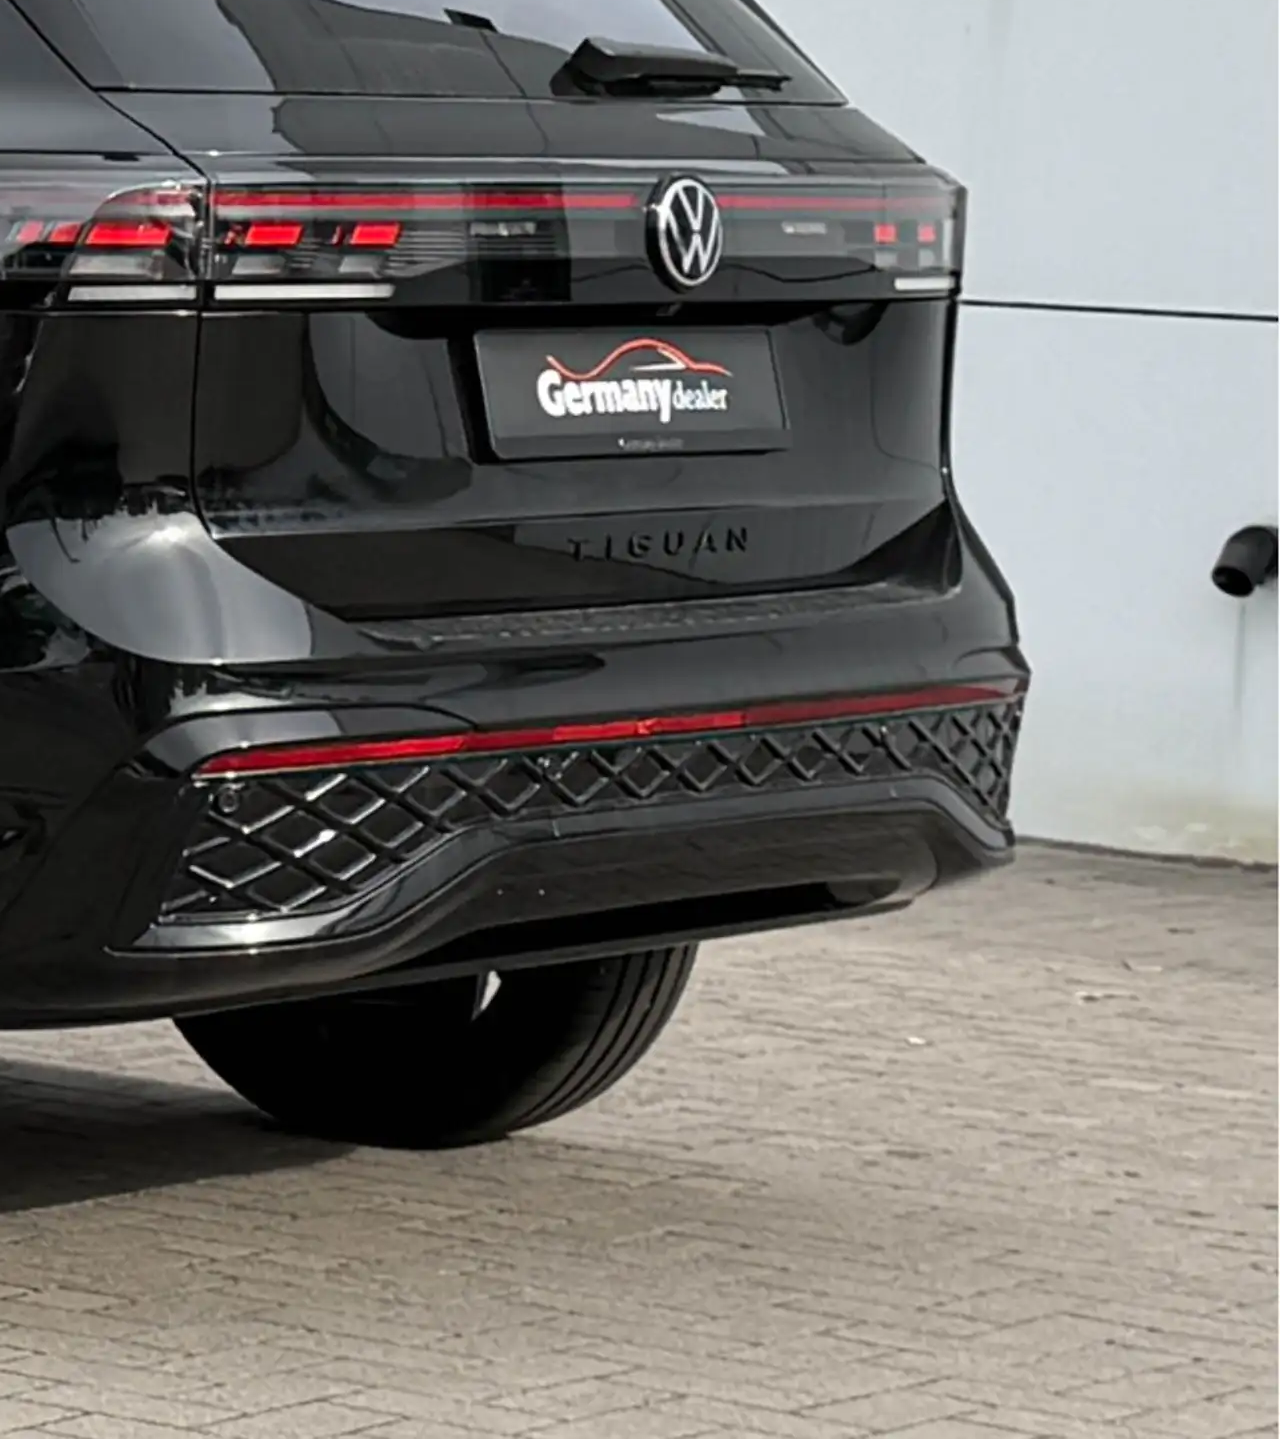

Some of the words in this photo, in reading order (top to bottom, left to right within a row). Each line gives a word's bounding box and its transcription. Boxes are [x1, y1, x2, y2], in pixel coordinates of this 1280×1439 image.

[536, 368, 672, 423] Germany
[671, 380, 729, 411] dealer
[566, 526, 748, 562] TIGUAN
